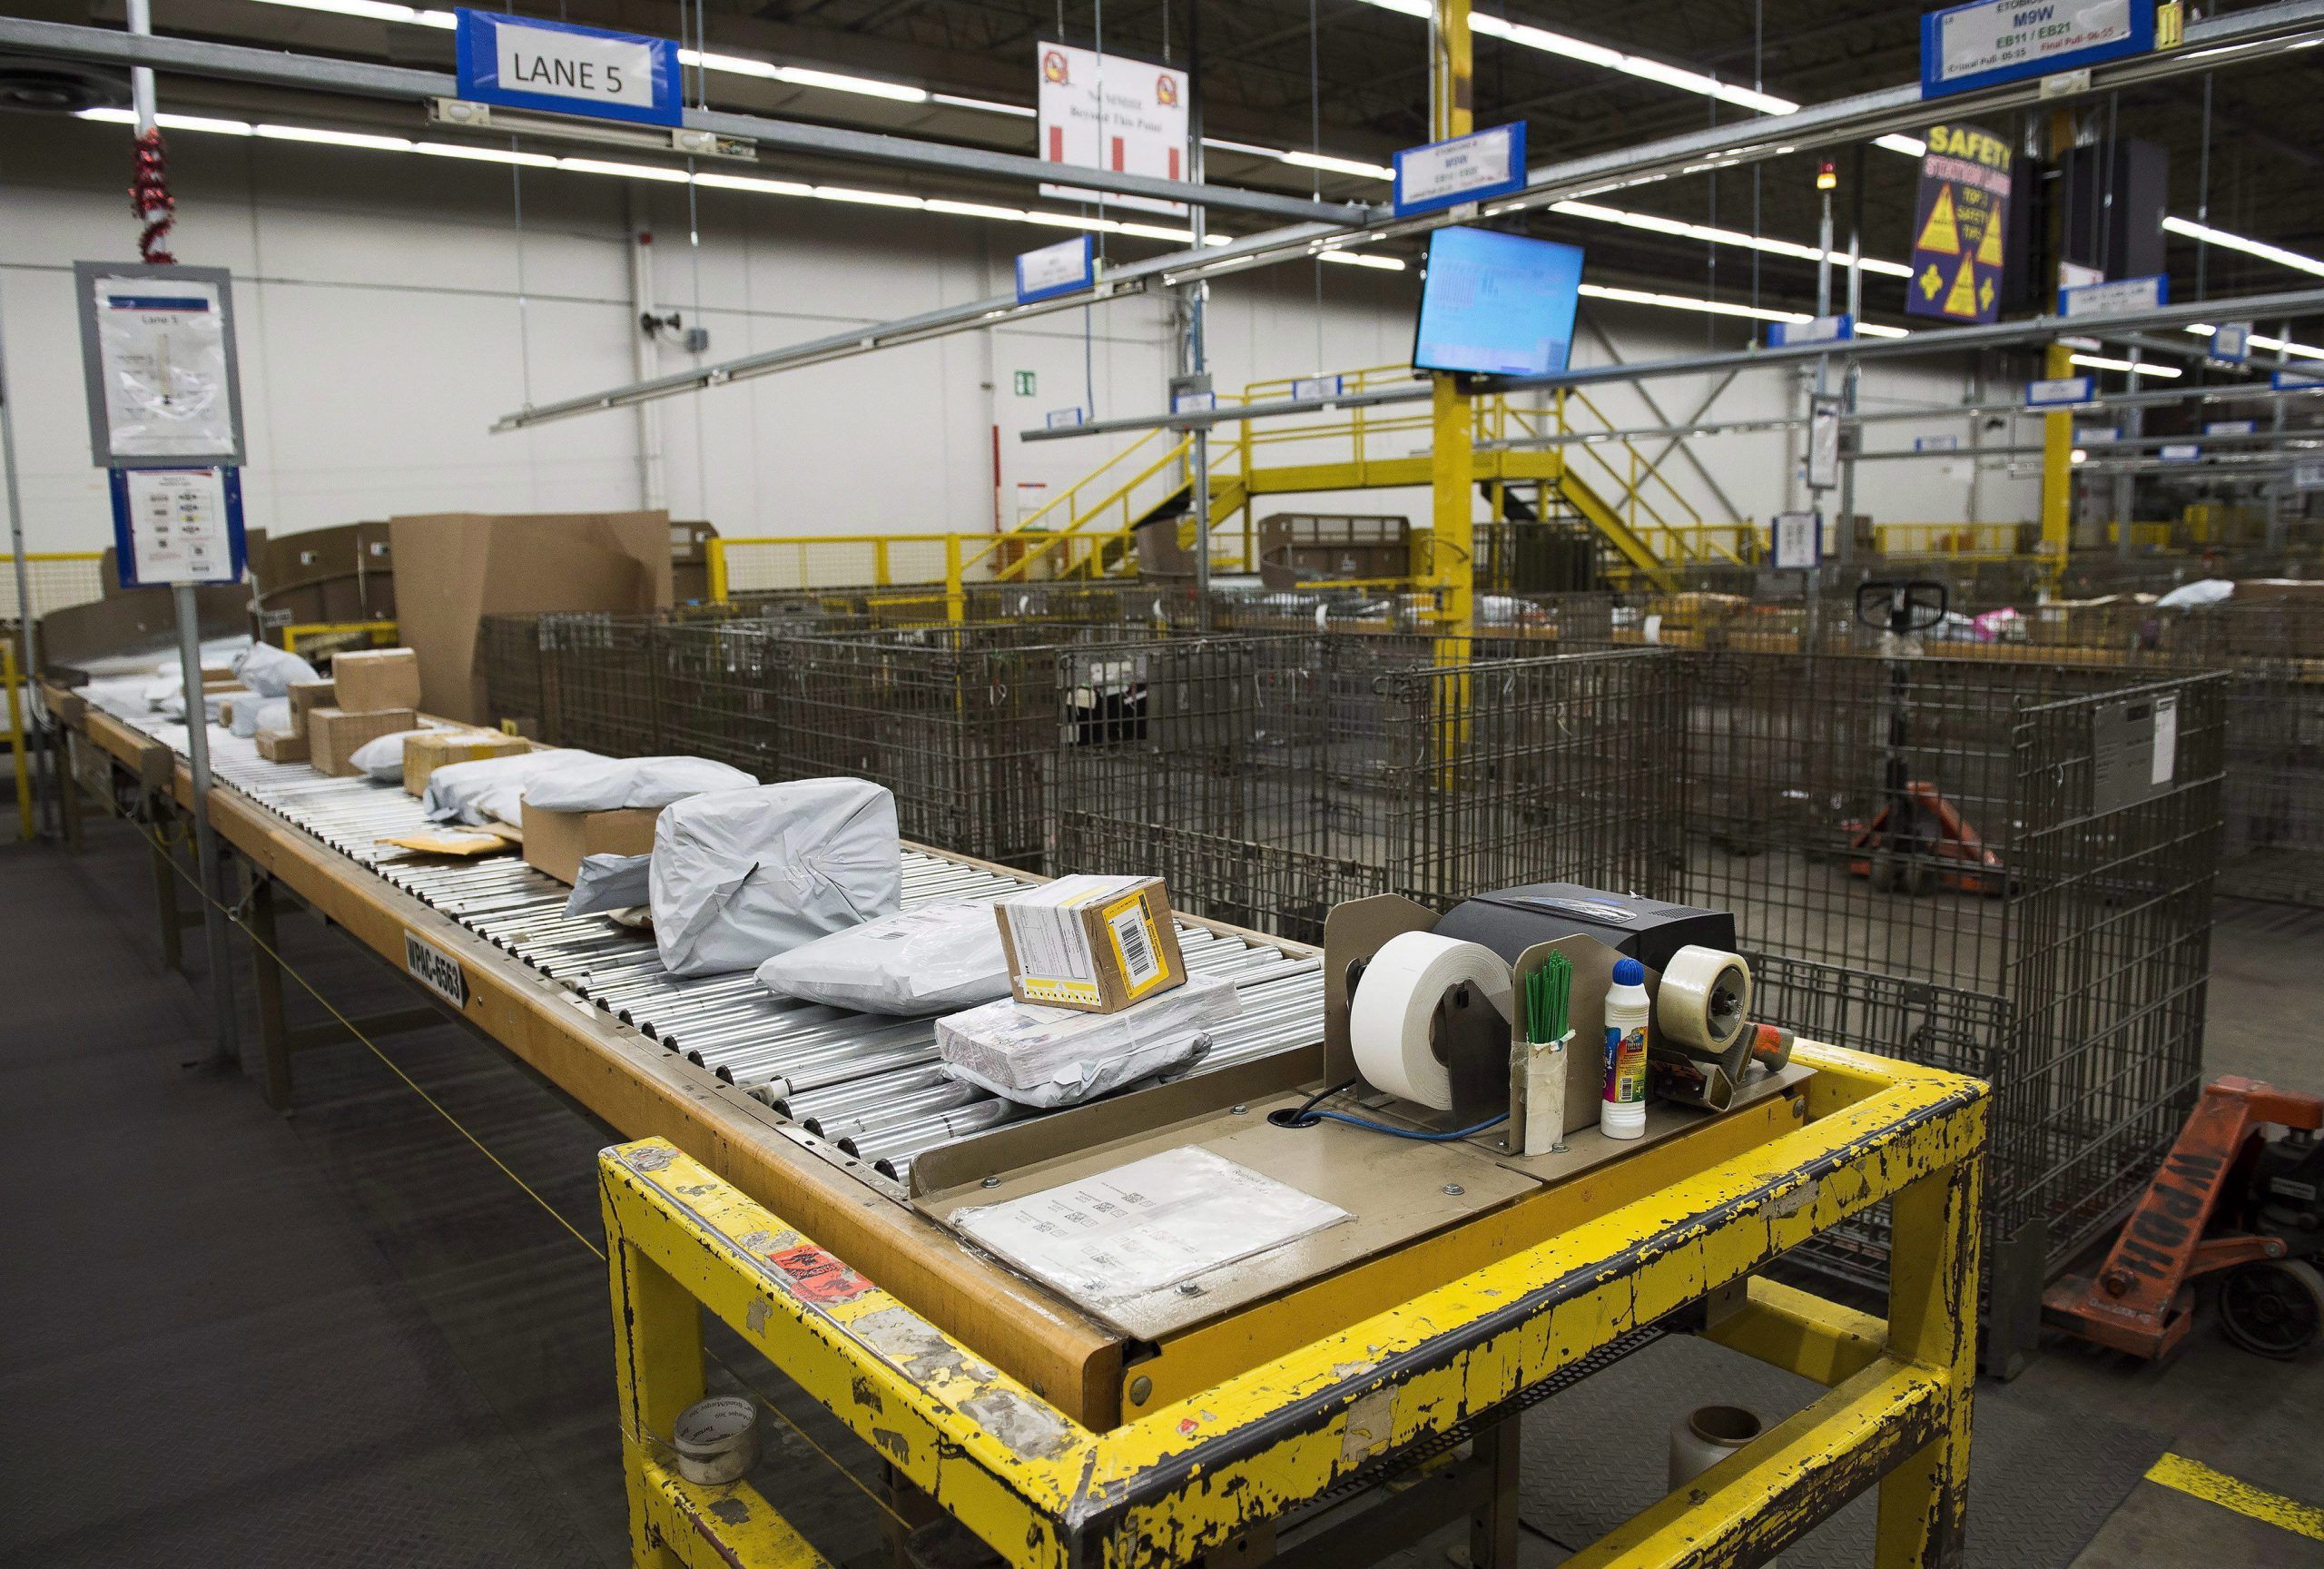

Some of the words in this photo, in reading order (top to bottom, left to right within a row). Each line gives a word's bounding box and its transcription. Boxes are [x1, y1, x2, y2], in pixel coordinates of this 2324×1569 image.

[2014, 5, 2054, 28] M9W
[1996, 33, 2027, 49] EB11
[2037, 21, 2071, 39] EB21
[514, 53, 595, 90] LANE
[606, 66, 623, 93] 5
[1929, 125, 2011, 171] SAFETY
